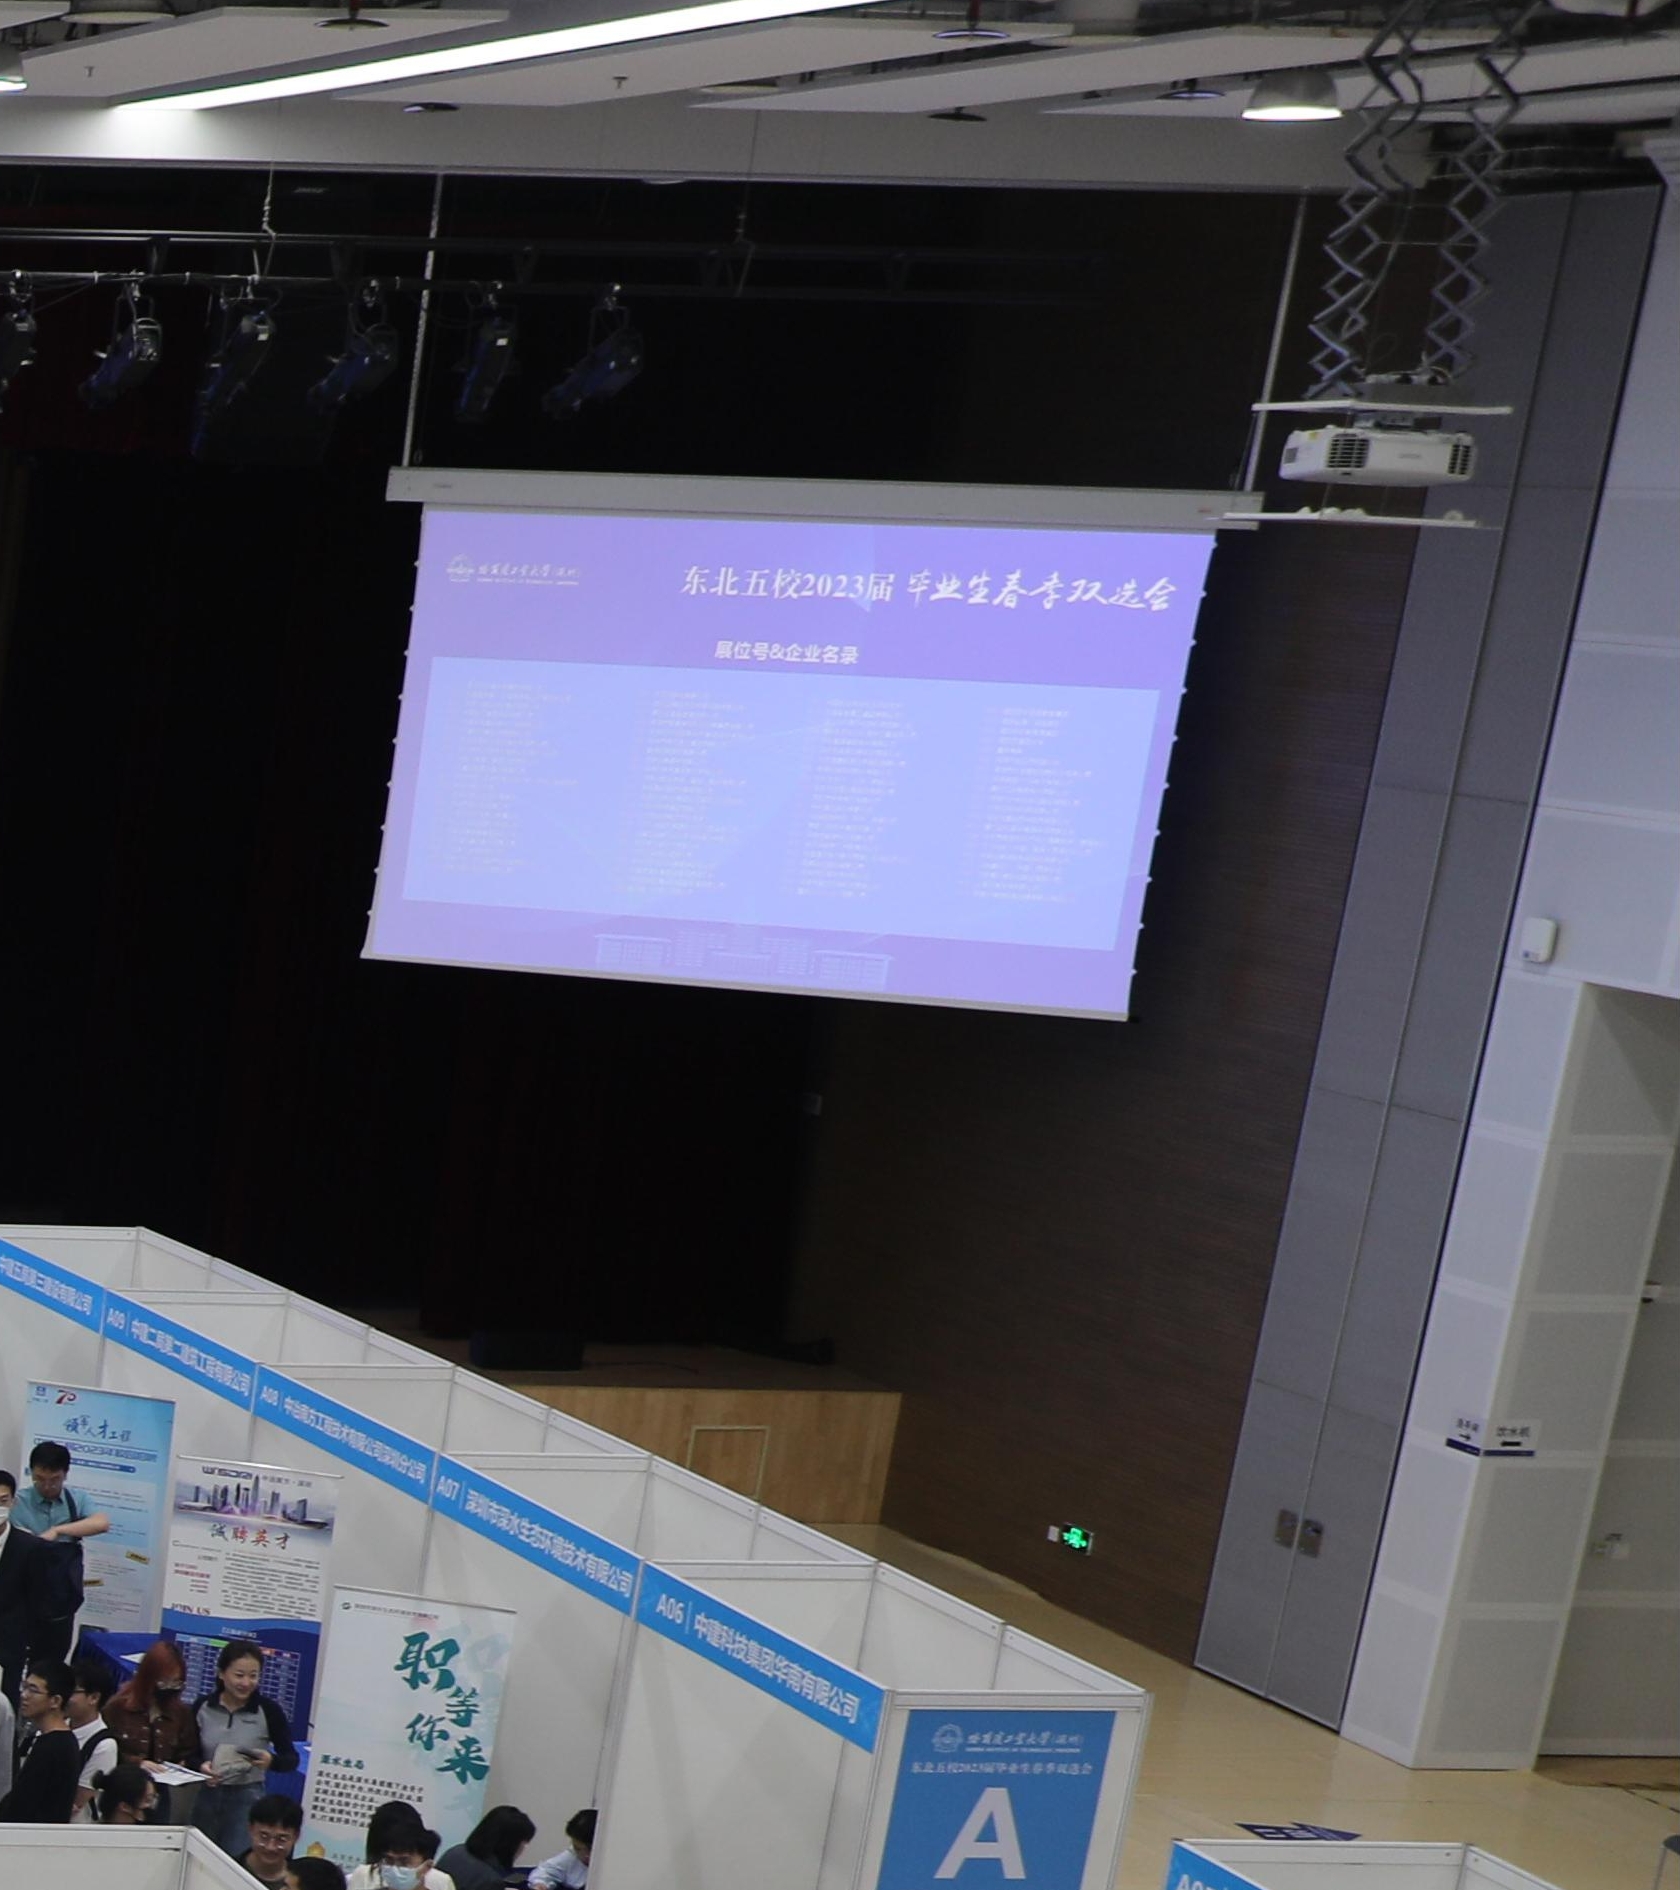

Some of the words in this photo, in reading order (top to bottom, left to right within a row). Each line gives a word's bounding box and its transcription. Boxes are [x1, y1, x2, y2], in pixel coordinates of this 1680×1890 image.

[678, 564, 894, 604] 东北五校2023届
[904, 568, 1180, 613] 毕业生春季双选会
[713, 639, 860, 666] 展位号&企业名录
[435, 1473, 459, 1502] A07
[654, 1592, 685, 1626] A06
[692, 1610, 861, 1726] 中建科技集团华南有限公司
[933, 1786, 1027, 1881] A
